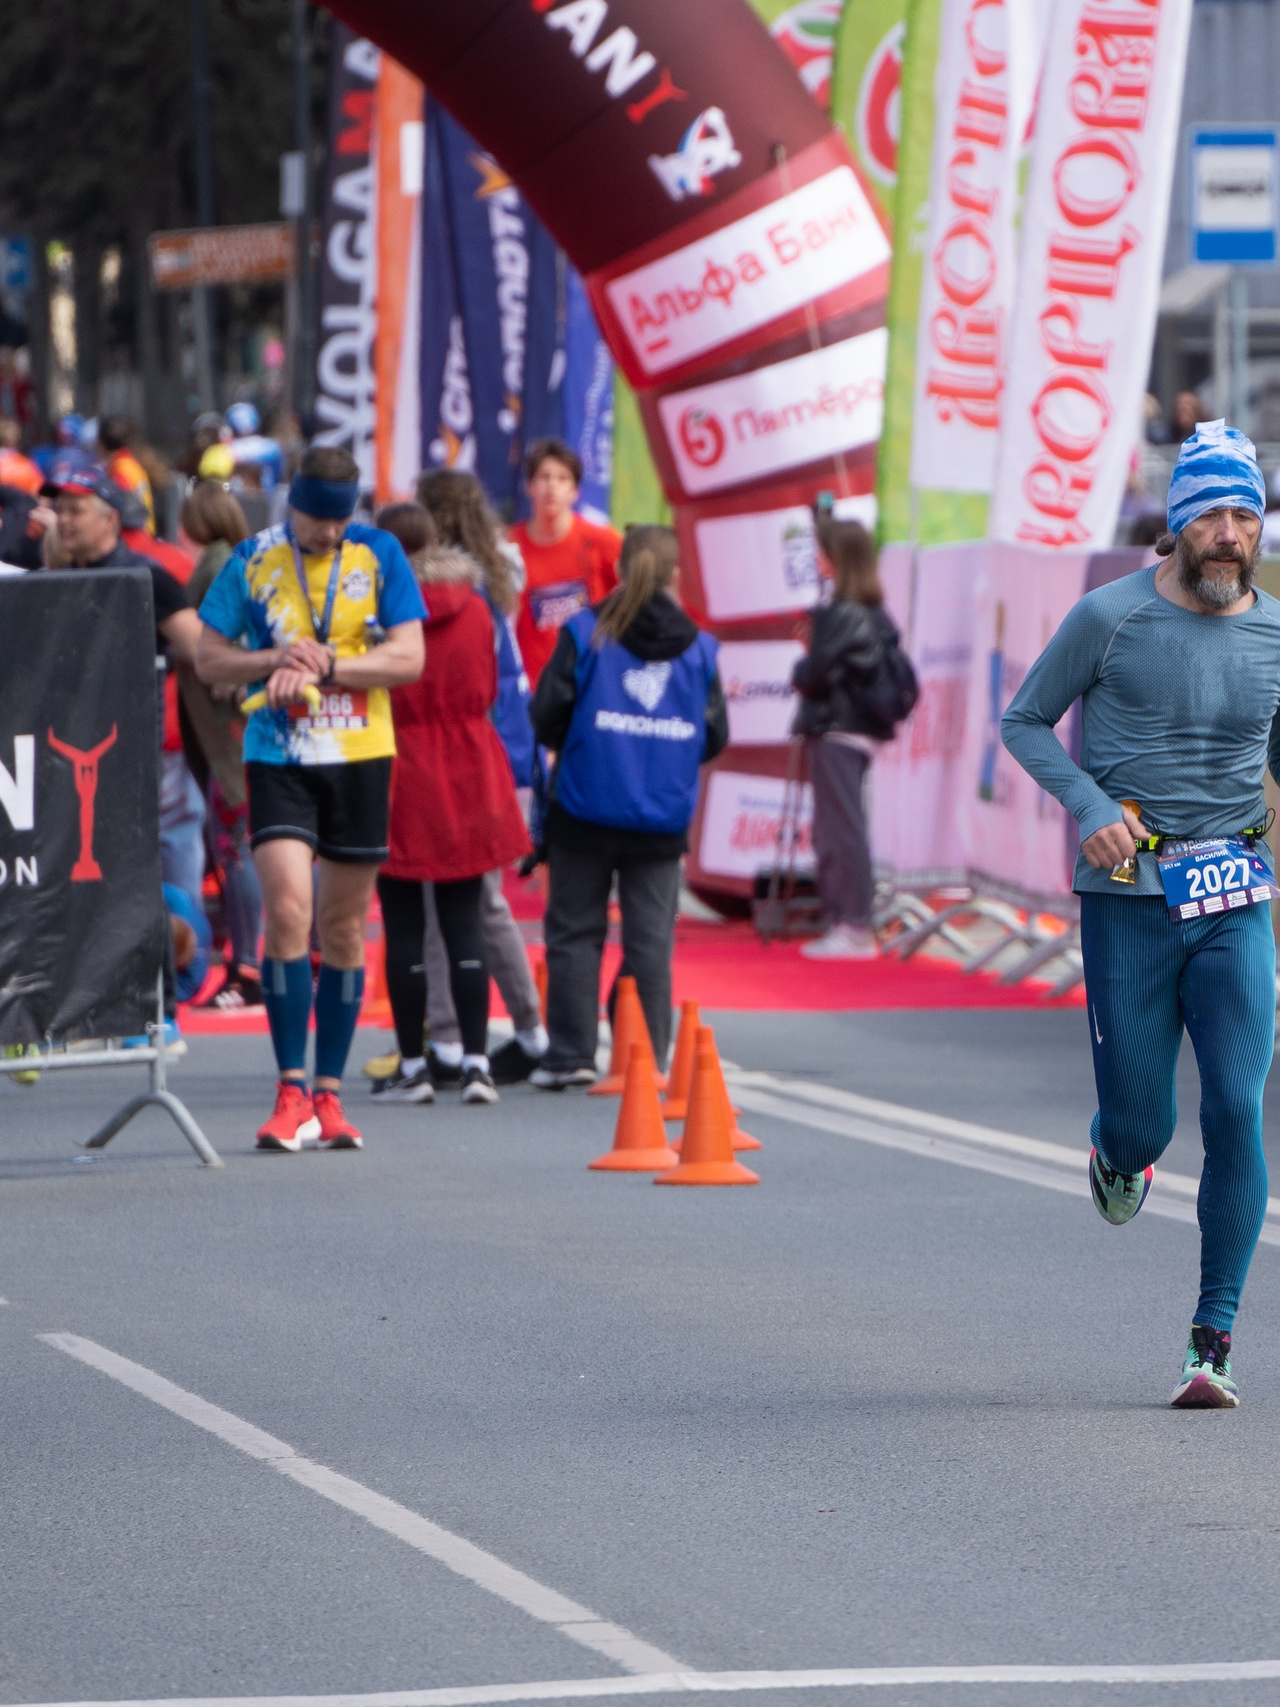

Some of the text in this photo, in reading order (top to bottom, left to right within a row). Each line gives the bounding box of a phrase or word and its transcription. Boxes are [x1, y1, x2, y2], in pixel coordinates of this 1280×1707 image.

[531, 0, 657, 98] AN
[1195, 848, 1229, 862] ВАСИЛИЙ
[1186, 858, 1250, 898] 2027
